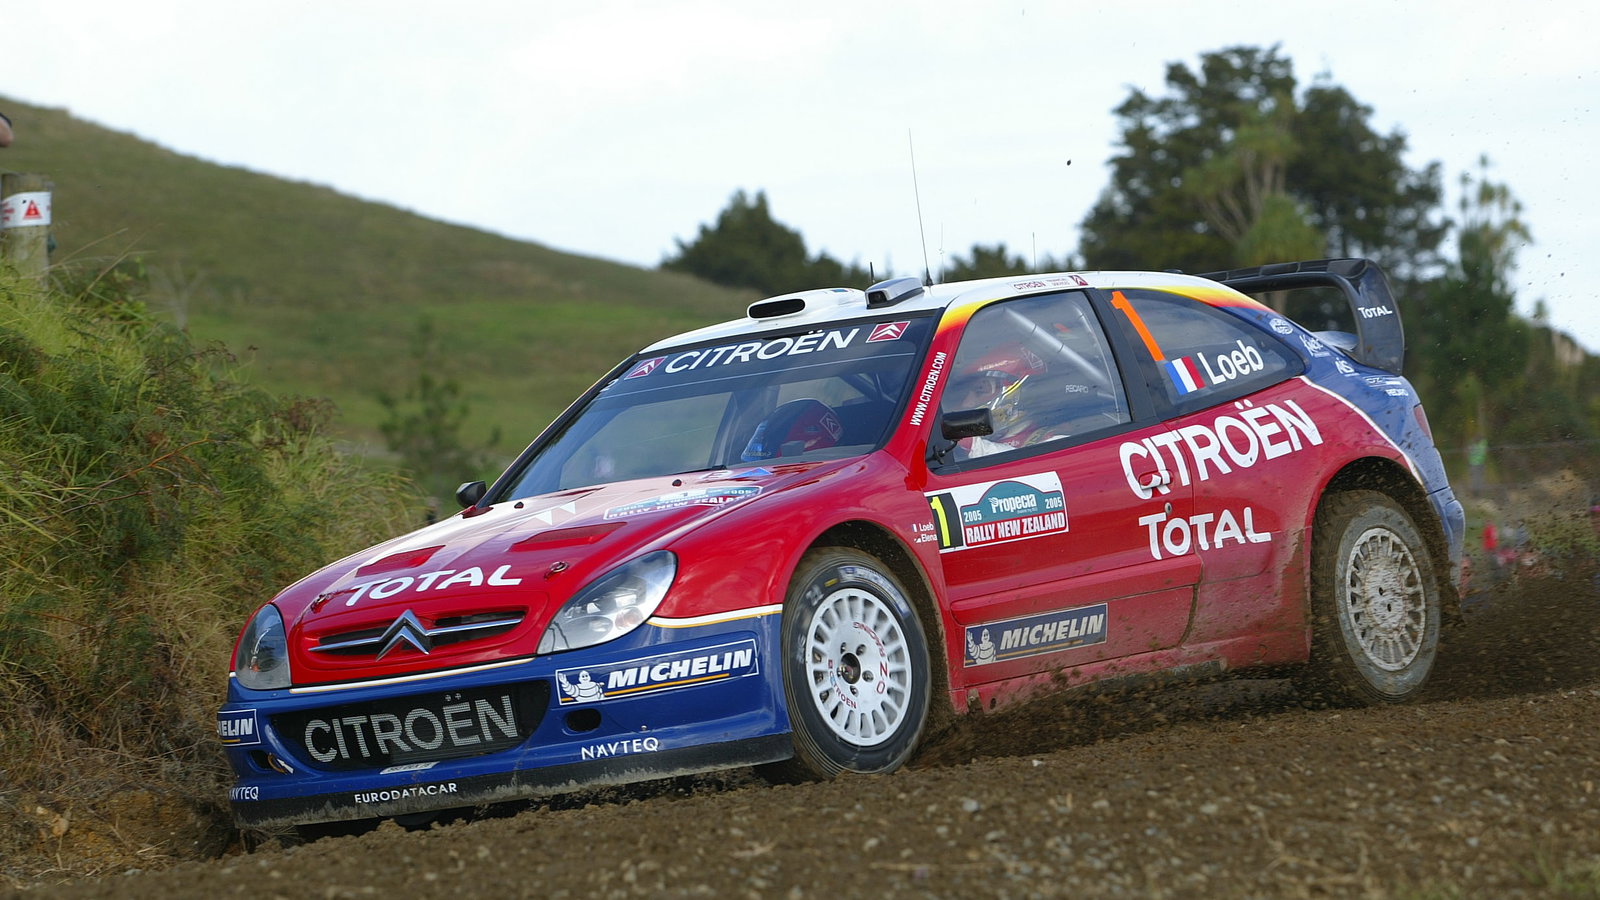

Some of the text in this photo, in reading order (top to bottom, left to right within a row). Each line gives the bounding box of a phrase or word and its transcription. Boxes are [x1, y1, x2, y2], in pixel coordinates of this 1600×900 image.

[1110, 291, 1165, 361] 1
[1357, 305, 1392, 318] TOTAL
[665, 330, 860, 374] CITROËN
[1197, 339, 1263, 385] Loeb
[910, 352, 947, 426] WWW.CITROEN.COM
[1065, 384, 1089, 394] RECARO
[1119, 399, 1323, 500] CITROËN
[656, 501, 689, 511] NEW
[930, 496, 951, 546] 1
[964, 510, 982, 523] 2005
[988, 494, 1037, 513] Propecia
[1045, 497, 1063, 509] 2005
[919, 522, 935, 532] Loeb
[966, 512, 1065, 543] RALLY NEW ZEALAND
[1139, 507, 1271, 560] TOTAL
[346, 565, 522, 606] TOTAL
[1000, 613, 1104, 650] MICHELIN
[607, 648, 752, 689] MICHELIN
[304, 693, 519, 763] CITROËN
[581, 737, 659, 760] NAVTEQ
[354, 783, 458, 803] EURODATACAR
